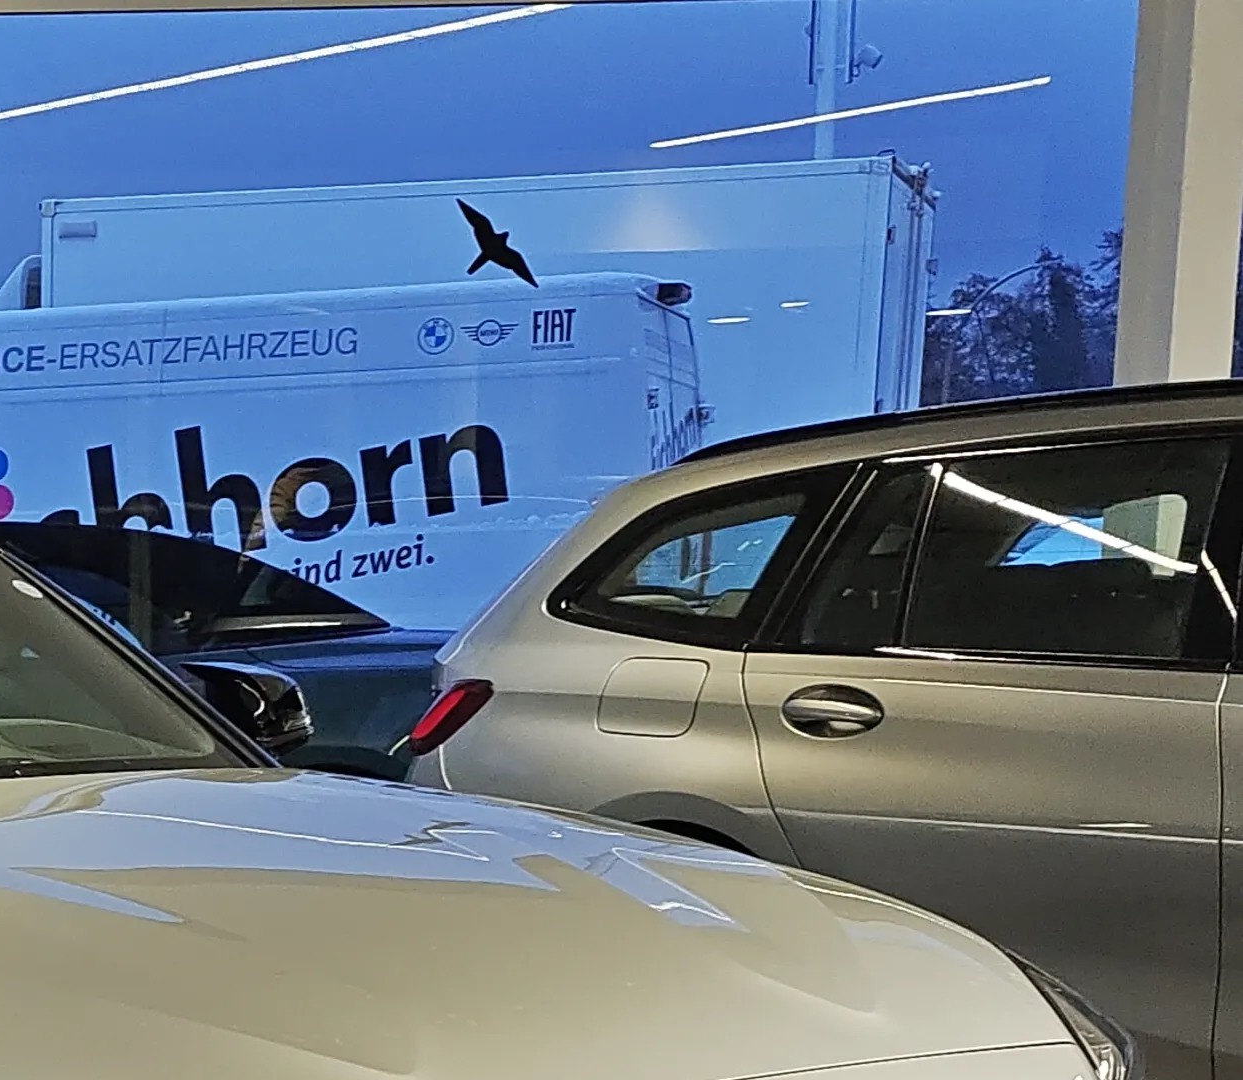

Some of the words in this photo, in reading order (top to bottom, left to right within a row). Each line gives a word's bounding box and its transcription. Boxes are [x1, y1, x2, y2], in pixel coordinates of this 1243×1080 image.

[532, 308, 576, 344] FIAT
[40, 424, 510, 553] hhorn
[283, 549, 343, 585] ind
[351, 533, 435, 579] zwei.
